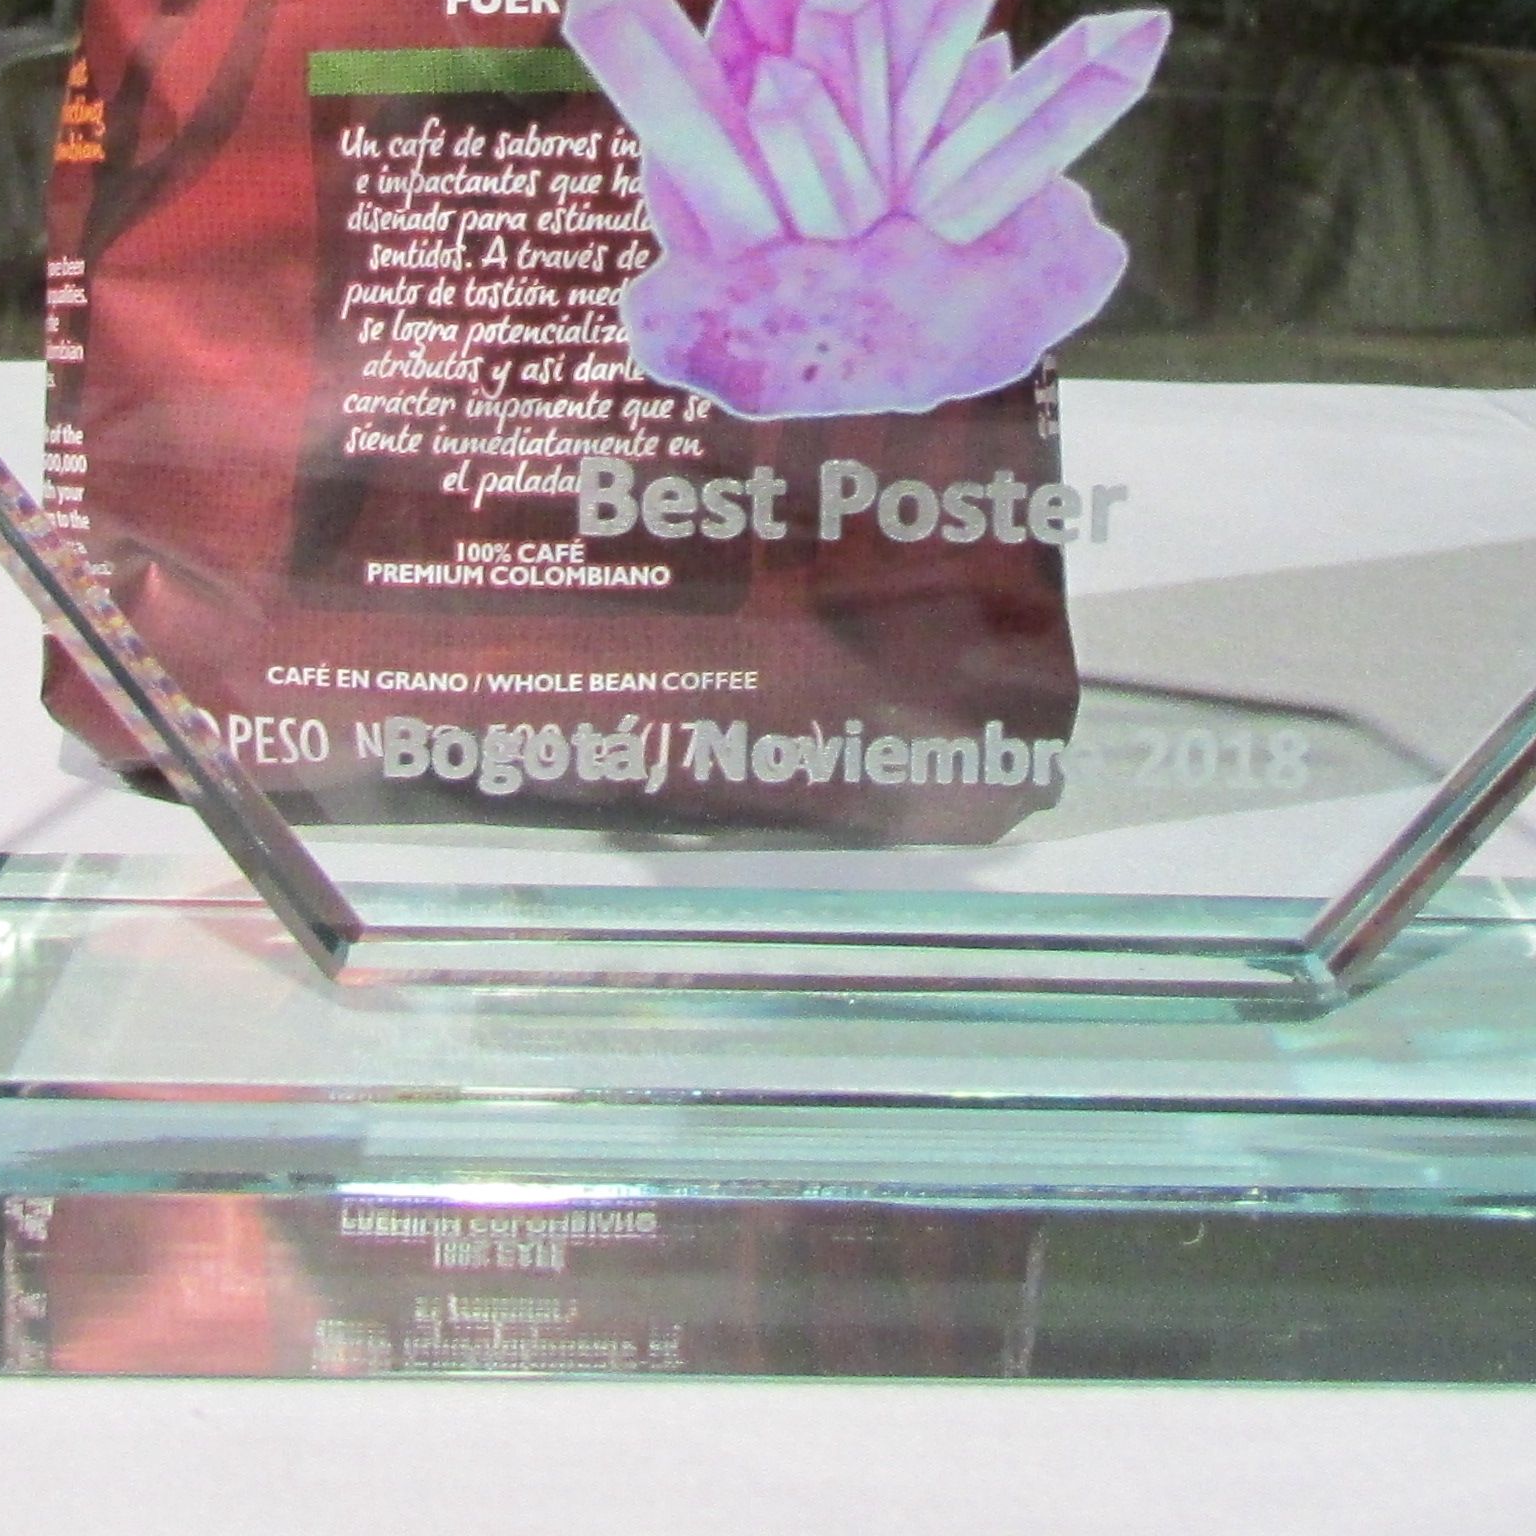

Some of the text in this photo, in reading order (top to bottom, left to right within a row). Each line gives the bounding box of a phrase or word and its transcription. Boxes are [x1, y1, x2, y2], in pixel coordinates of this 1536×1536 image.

[340, 117, 643, 171] Un café de sabores in
[356, 173, 368, 194] e
[378, 165, 542, 208] impactantes
[548, 169, 602, 205] que
[347, 200, 455, 233] diseñado
[457, 210, 527, 244] para
[369, 237, 650, 272] sentidos. A través de
[340, 280, 423, 319] punto
[427, 275, 454, 306] de
[464, 276, 560, 309] tostión
[358, 318, 382, 344] se
[392, 311, 459, 360] logra
[362, 351, 481, 383] atributos
[483, 364, 513, 400] y
[520, 354, 566, 382] así
[343, 388, 711, 432] carácter imponente que se
[345, 424, 706, 458] siente inmediatamente en
[43, 453, 88, 476] 00,000
[442, 462, 469, 493] el
[577, 457, 1128, 544] Best Poster
[455, 538, 586, 564] 100% CAFÉ
[366, 562, 672, 588] PREMIUM COLOMBIANO
[266, 663, 331, 688] CAFÉ
[336, 667, 371, 689] EN
[375, 669, 469, 693] GRANO
[488, 672, 584, 694] WHOLE
[589, 671, 658, 693] BEAN
[661, 670, 759, 692] COFFEE
[228, 713, 331, 764] PESO
[383, 714, 671, 795] Bogotá,
[693, 718, 1107, 787] Noviembre
[1123, 727, 1310, 790] 2018
